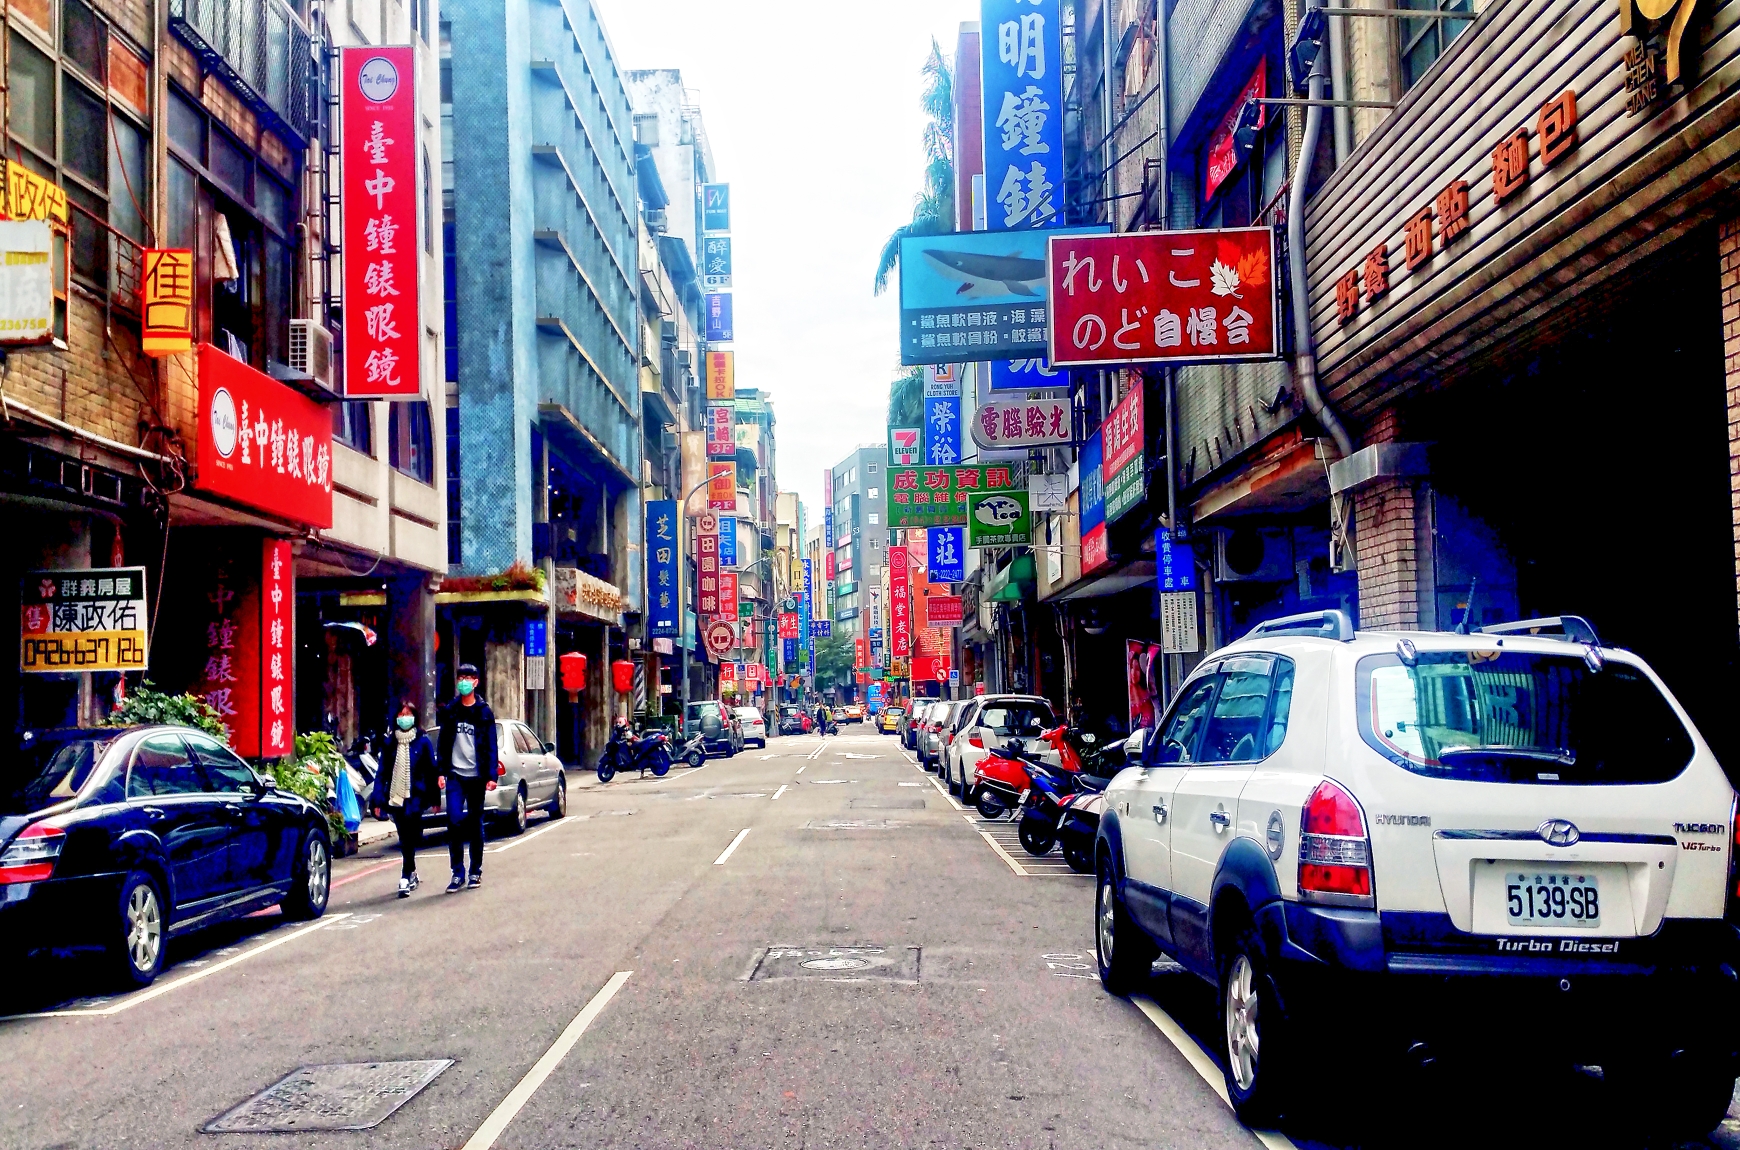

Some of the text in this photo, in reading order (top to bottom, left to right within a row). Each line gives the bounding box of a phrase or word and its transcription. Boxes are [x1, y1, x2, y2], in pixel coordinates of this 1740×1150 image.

[1624, 40, 1645, 72] MEI
[1624, 54, 1655, 94] CHEN
[995, 0, 1057, 228] 明鐘錶
[1625, 79, 1657, 119] SIANG
[1403, 180, 1469, 271] 西點
[1491, 89, 1578, 205] 麵包
[363, 119, 402, 386] 臺中鐘錶眼鏡
[706, 276, 729, 285] 6F
[1062, 248, 1200, 297] れいこ
[1072, 306, 1254, 352] のど自慢会
[716, 408, 729, 442] 宮崎
[980, 406, 1069, 441] 電腦驗光
[238, 399, 331, 493] 臺中鐘錶眼鏡
[711, 444, 732, 455] 3F
[893, 467, 1013, 490] 成功資訊
[1161, 531, 1174, 588] 收費停車處
[61, 577, 132, 597] 群義房屋
[52, 600, 137, 632] 陳政佑
[780, 614, 798, 630] 新生
[893, 574, 908, 652] 一福堂老店
[270, 547, 284, 749] 臺中鐘錶眼鏡
[1375, 813, 1432, 827] HYUNDAI
[1507, 884, 1599, 920] 5139-SB
[1496, 938, 1619, 953] Turbo Diesel
